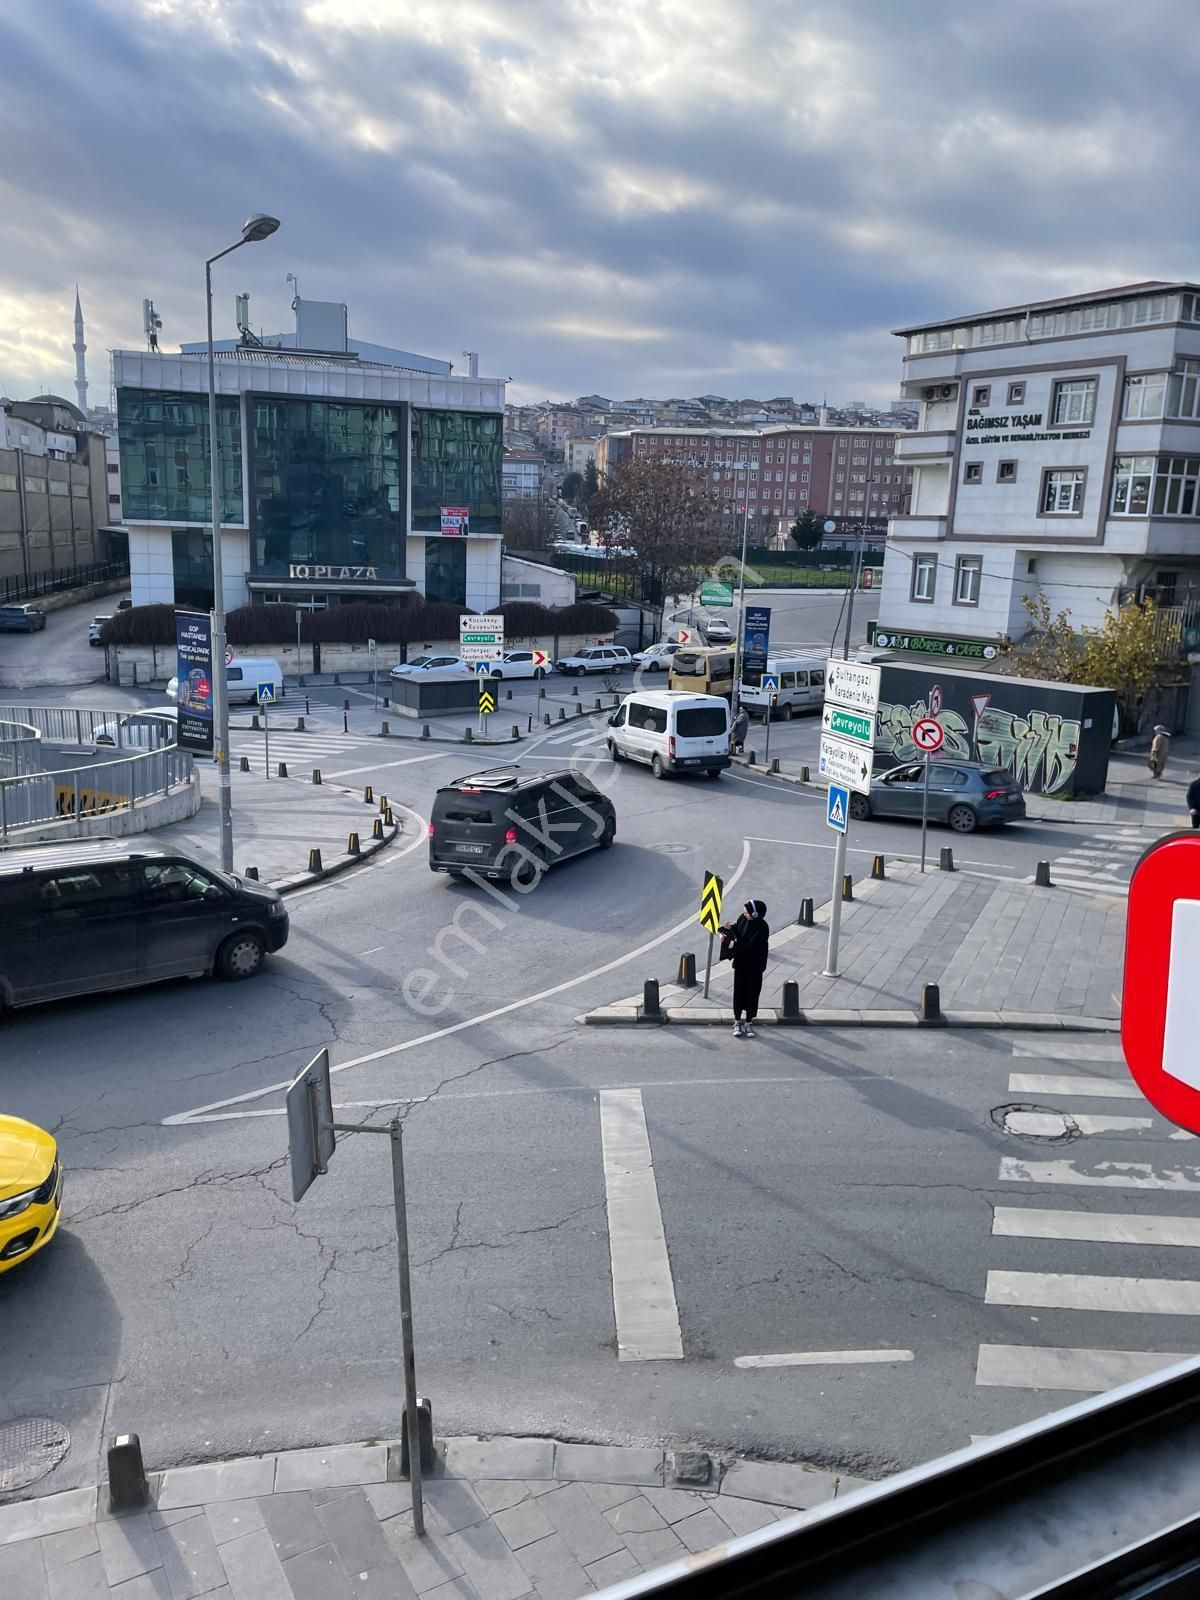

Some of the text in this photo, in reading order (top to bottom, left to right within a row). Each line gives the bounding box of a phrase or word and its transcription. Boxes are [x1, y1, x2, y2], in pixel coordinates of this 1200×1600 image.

[967, 414, 1042, 430] BAĞIMSIZ YAŞAM
[289, 564, 378, 581] IQ PLAZA
[946, 644, 955, 654] &
[837, 667, 872, 686] Sultangazi
[835, 685, 861, 702] Karadeniz
[832, 712, 870, 735] Çevreyolu
